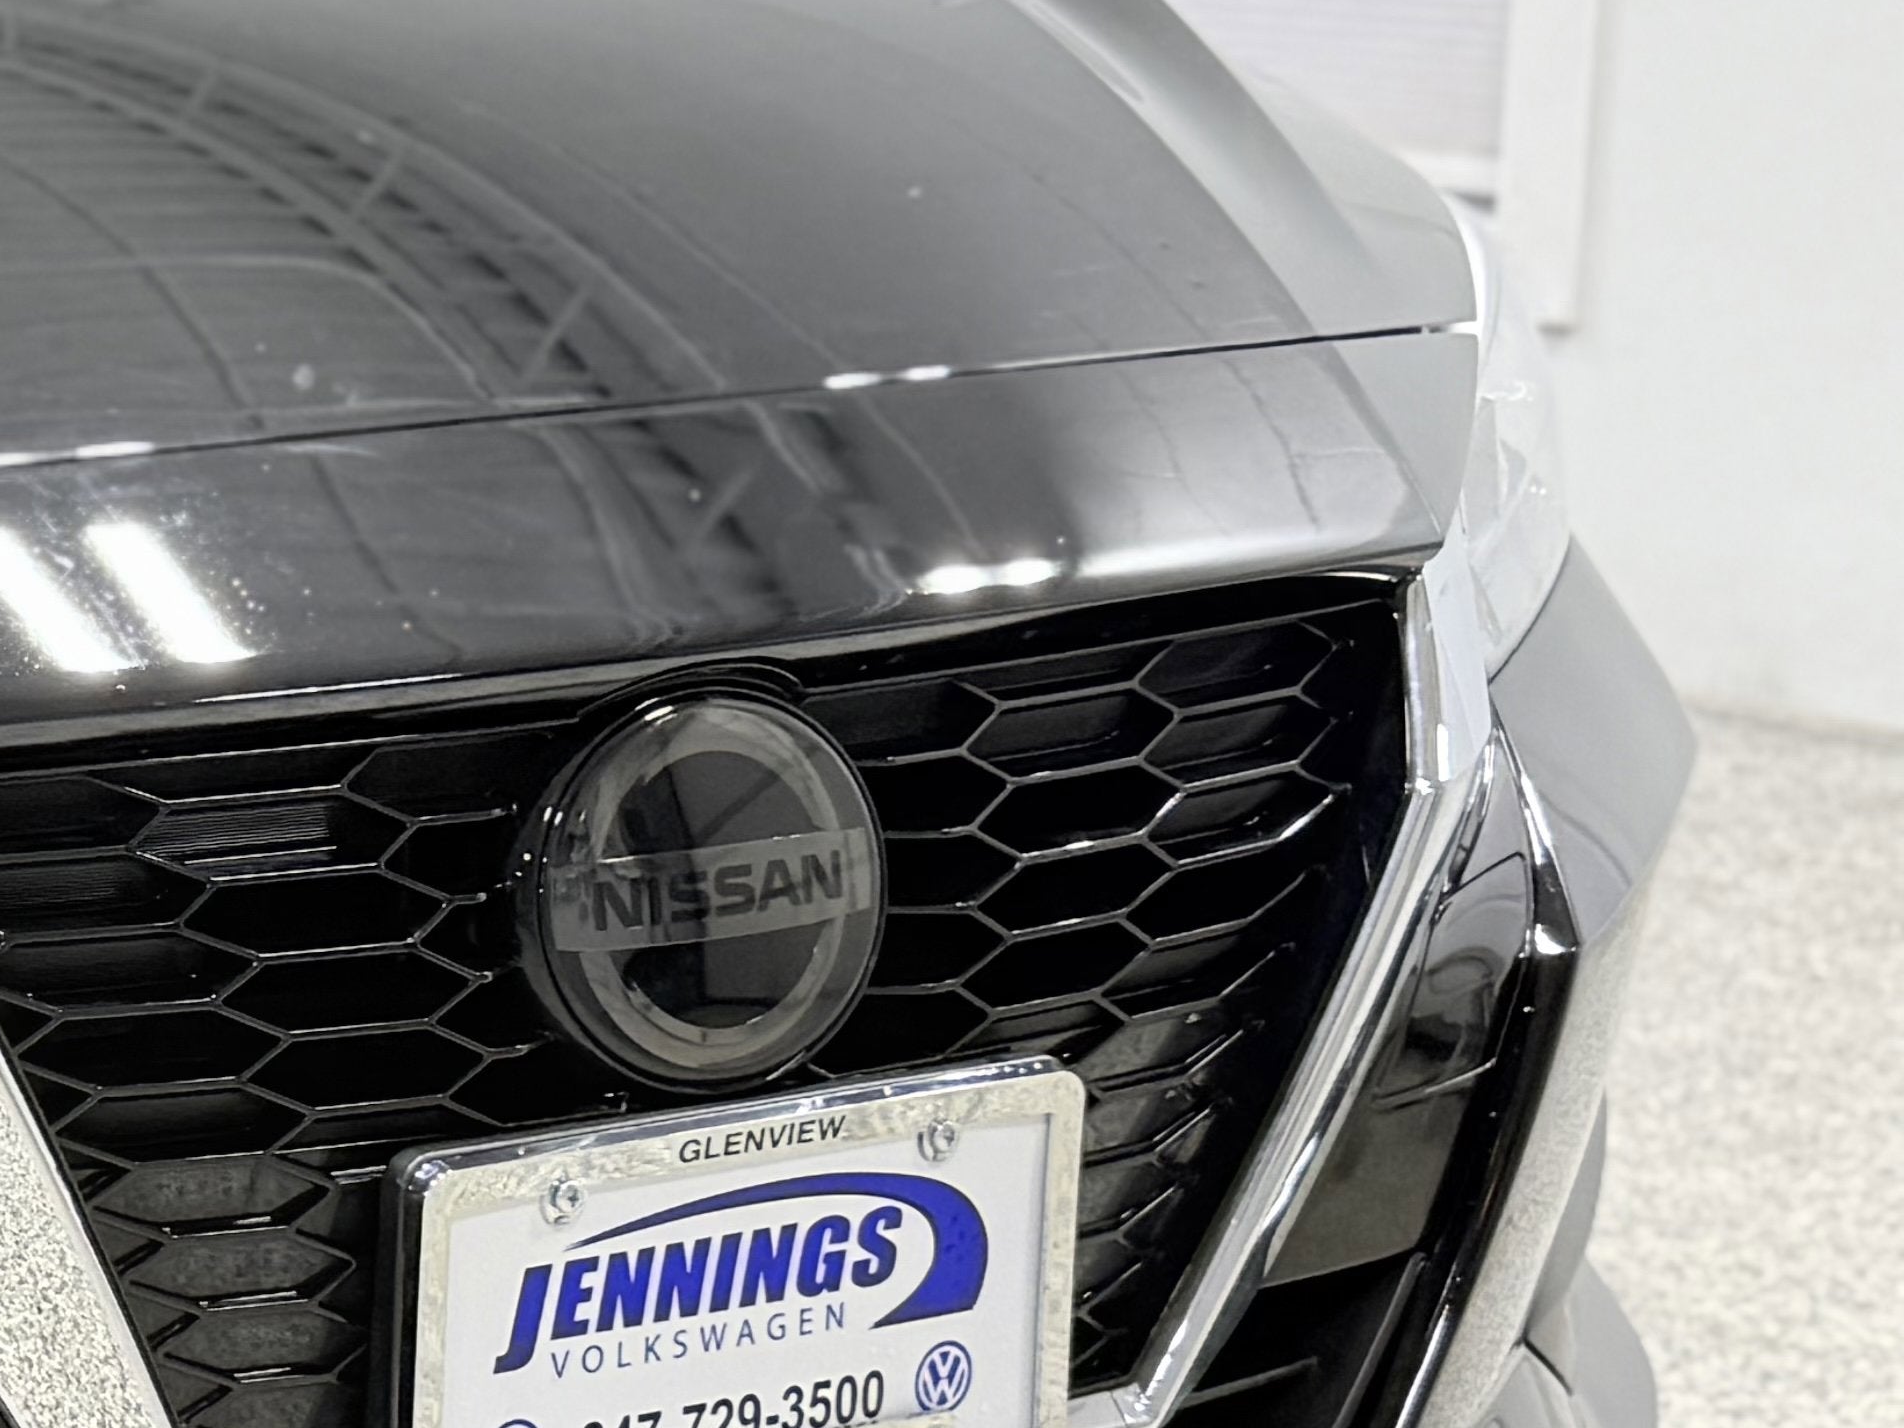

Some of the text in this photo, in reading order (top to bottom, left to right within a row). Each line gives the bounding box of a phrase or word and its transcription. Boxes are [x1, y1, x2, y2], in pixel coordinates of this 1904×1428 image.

[593, 849, 844, 933] NISSAN
[677, 1115, 845, 1164] GLENVIEW
[492, 1206, 903, 1375] JENNINGS
[549, 1301, 847, 1379] VOLKSWAGEN
